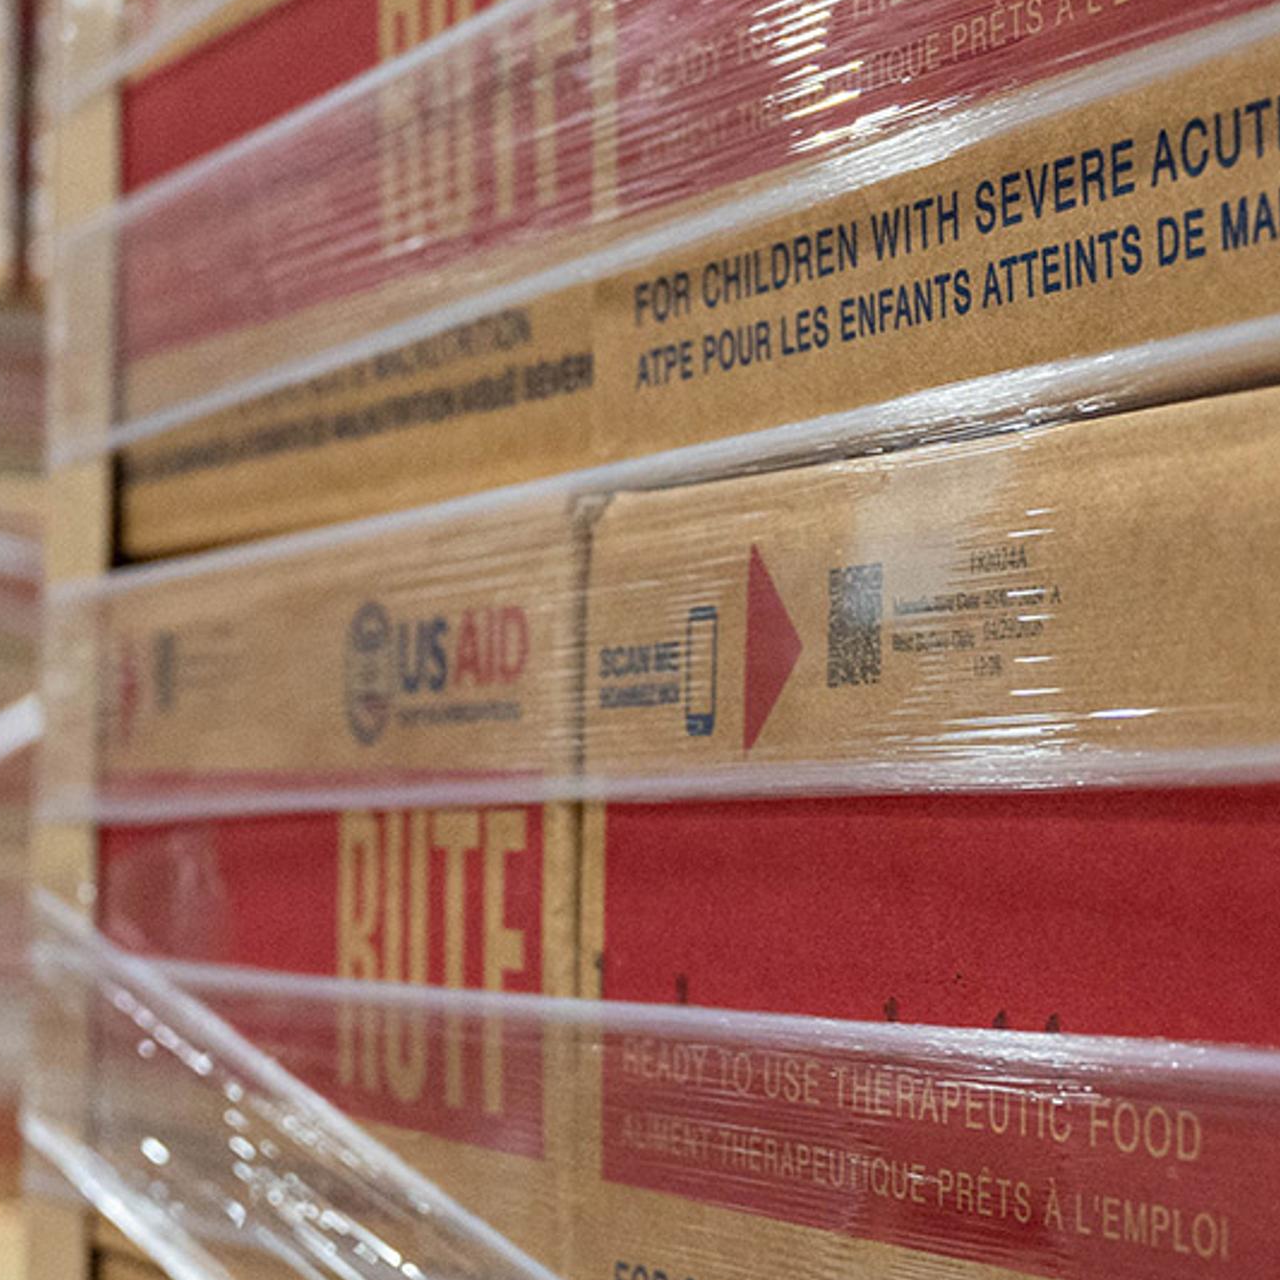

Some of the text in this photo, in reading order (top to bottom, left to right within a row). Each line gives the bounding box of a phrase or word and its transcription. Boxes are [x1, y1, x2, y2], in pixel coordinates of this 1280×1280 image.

[635, 272, 690, 324] FOR
[703, 222, 857, 307] CHILDREN
[872, 191, 958, 261] WITH
[975, 139, 1135, 235] SEVERE
[636, 341, 693, 389] ATPE
[704, 320, 771, 376] POUR
[781, 305, 830, 356] LES
[841, 268, 971, 342] ENFANTS
[982, 223, 1142, 309] ATTEINTS
[1158, 208, 1206, 267] DE
[396, 604, 530, 696] USAID
[337, 807, 528, 1115] RUTF
[622, 1033, 1202, 1161] READY TO USE THERAPEUTIC FOOD
[938, 1167, 1032, 1223] PRÊTS
[1045, 1177, 1064, 1231] À
[1076, 1193, 1230, 1260] L'EMPLOI
